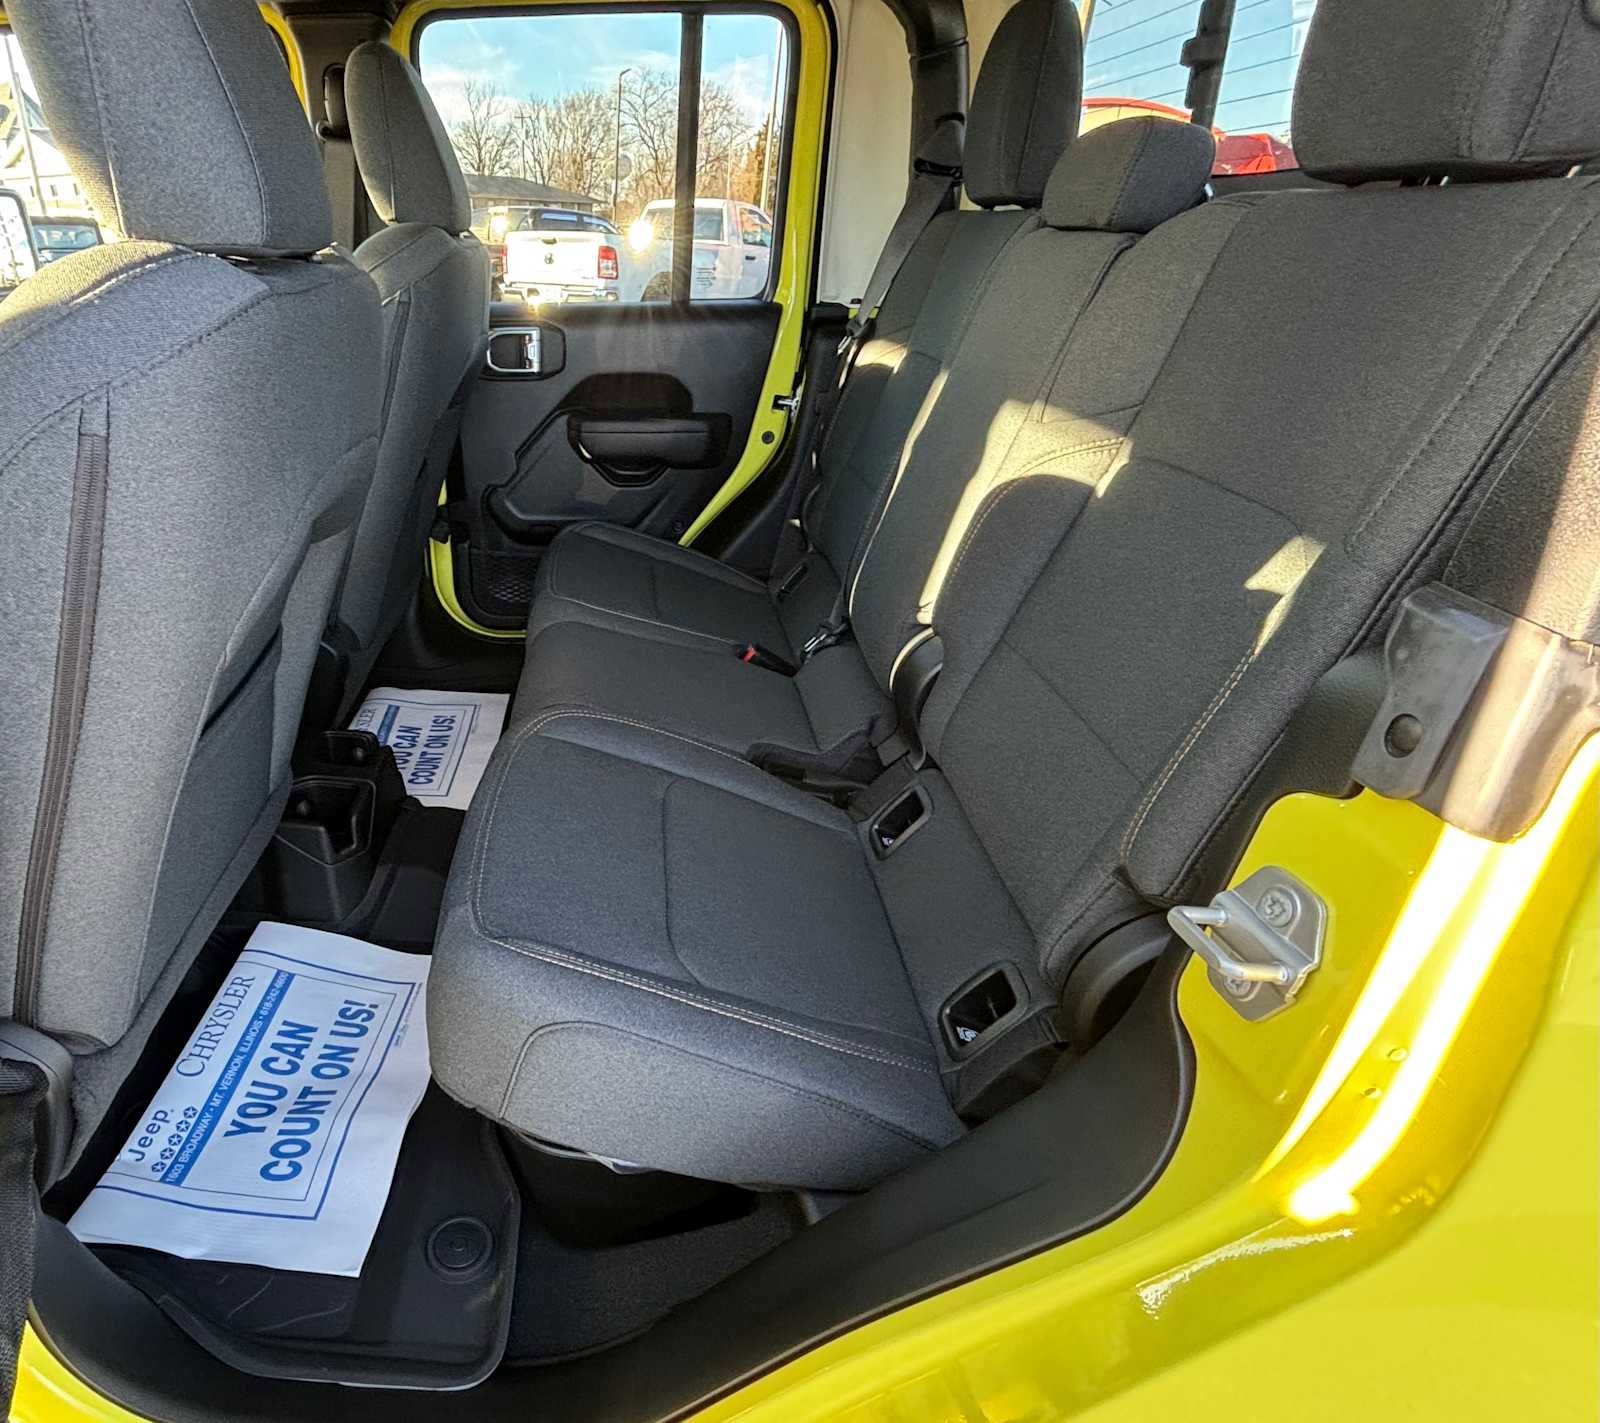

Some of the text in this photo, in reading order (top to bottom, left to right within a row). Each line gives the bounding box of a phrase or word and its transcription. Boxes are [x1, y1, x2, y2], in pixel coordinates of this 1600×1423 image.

[393, 725, 422, 748] CAN
[408, 715, 456, 784] COUNT ON US!
[177, 976, 256, 1077] CHRYSLER
[178, 1111, 213, 1163] BROADWAY
[239, 1019, 264, 1053] ILLINOIS
[223, 1020, 318, 1138] YOU CAN
[259, 999, 379, 1182] COUNT ON US!
[128, 1110, 170, 1162] Jeep
